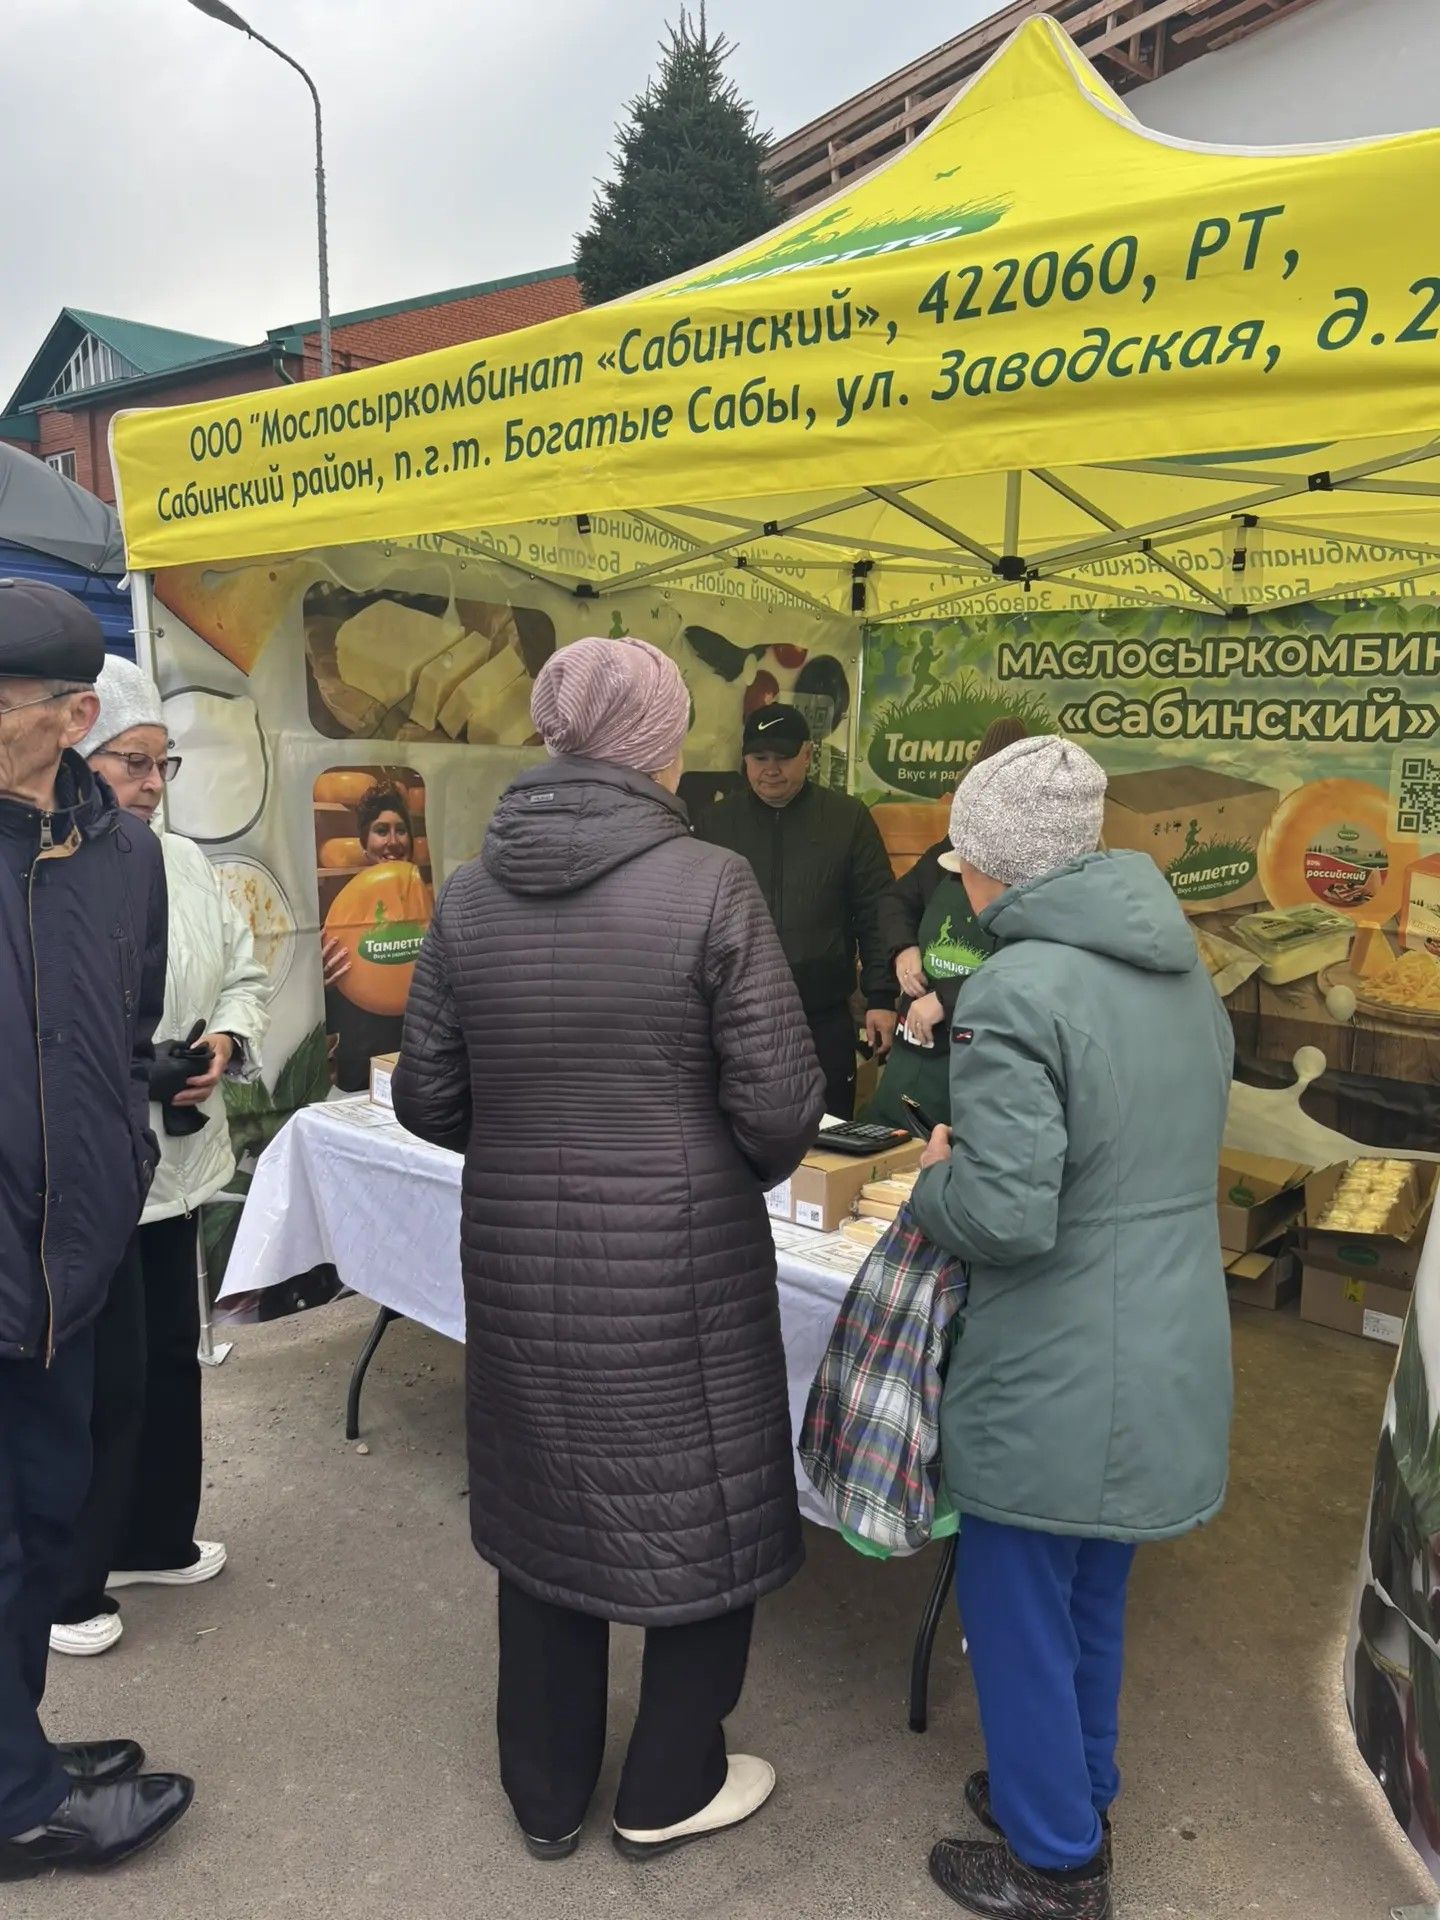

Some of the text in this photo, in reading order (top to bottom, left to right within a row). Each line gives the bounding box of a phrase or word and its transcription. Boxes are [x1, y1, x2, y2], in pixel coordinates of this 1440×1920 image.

[190, 204, 1300, 462] ООО "Мослосыркомбинат «Сабинский», 422060, РТ,
[158, 453, 284, 522] Сабинский
[291, 452, 384, 508] район,
[394, 437, 491, 481] п.г.т.
[504, 404, 674, 462] Богатые
[687, 376, 817, 434] Сабы,
[836, 370, 909, 428] ул.
[930, 319, 1281, 402] Заводская,
[1059, 688, 1439, 742] «Сабинский»
[885, 733, 982, 762] Тамле
[897, 767, 926, 782] Вкус
[929, 772, 937, 780] и
[1170, 861, 1251, 887] Тамлетто
[1306, 869, 1367, 881] российский
[929, 953, 978, 975] Тамлет
